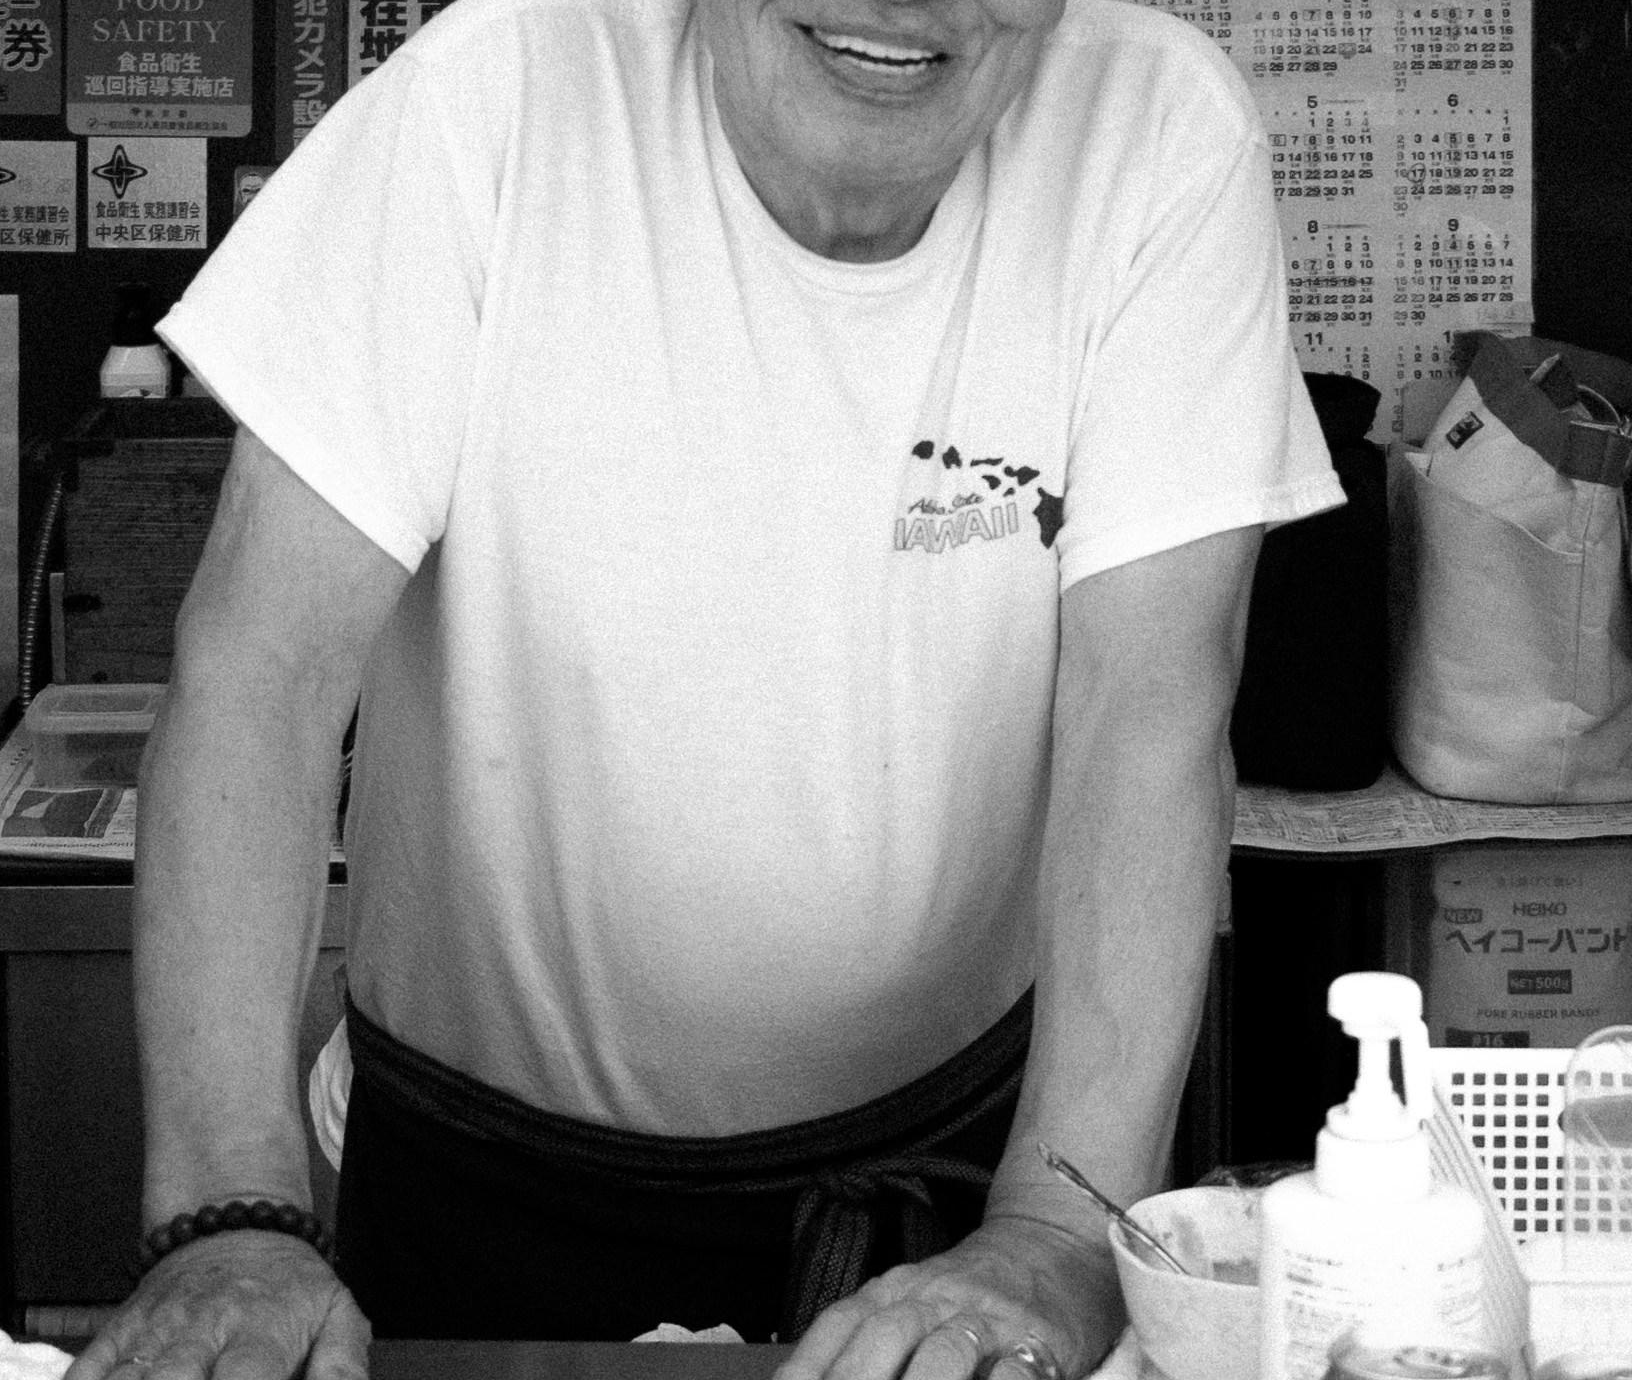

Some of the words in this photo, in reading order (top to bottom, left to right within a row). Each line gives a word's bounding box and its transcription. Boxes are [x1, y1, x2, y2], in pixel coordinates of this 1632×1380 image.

[91, 20, 228, 43] SAFETY
[117, 52, 203, 74] 食品衛生
[84, 74, 235, 98] 巡回指導実施店
[1306, 95, 1318, 109] 5
[1447, 93, 1459, 108] 6
[1306, 220, 1319, 234] 8
[1447, 218, 1459, 233] 9
[94, 223, 201, 244] 中央区保健所
[1304, 331, 1324, 346] 11
[1512, 901, 1568, 917] HEIKO
